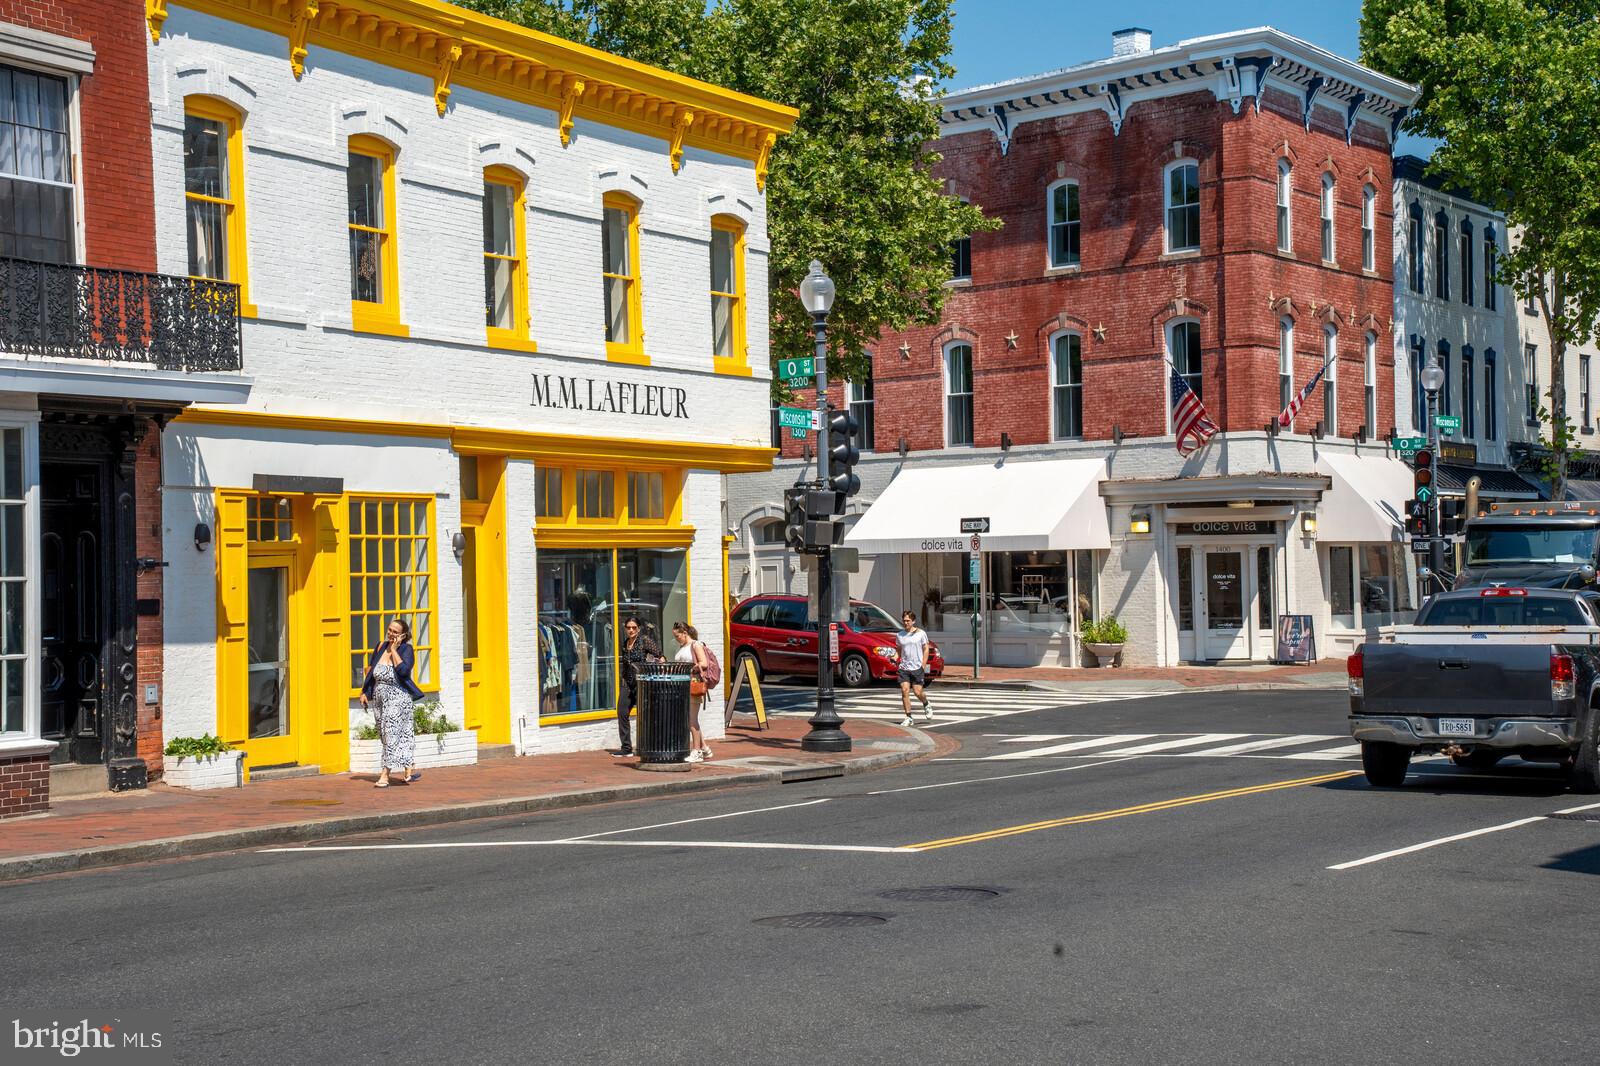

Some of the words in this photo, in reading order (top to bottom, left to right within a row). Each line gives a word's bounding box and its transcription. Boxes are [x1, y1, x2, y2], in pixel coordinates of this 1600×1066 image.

[788, 362, 796, 376] O
[789, 377, 809, 388] 3200
[530, 373, 582, 411] M.M.
[586, 378, 690, 419] LAFLEUR
[780, 410, 806, 425] Wisconsin
[1435, 416, 1455, 427] Wisconsin
[791, 428, 806, 438] 1300
[1444, 427, 1454, 435] 1400
[1400, 440, 1408, 448] O
[1193, 521, 1229, 532] dolce
[1233, 521, 1256, 531] vita
[921, 539, 946, 551] dolce
[947, 539, 963, 550] vita
